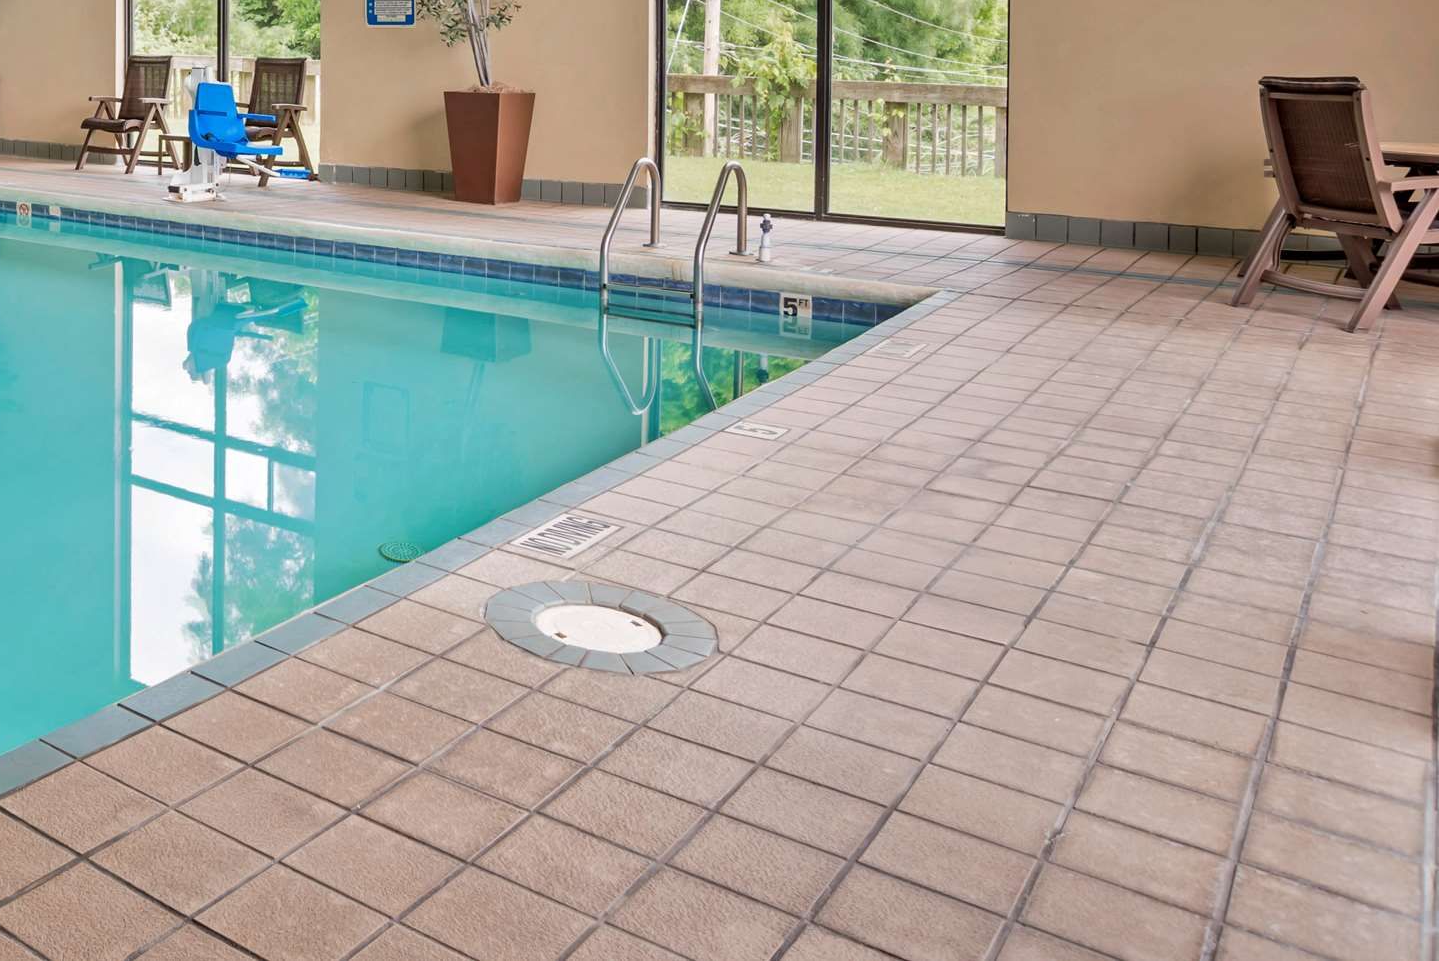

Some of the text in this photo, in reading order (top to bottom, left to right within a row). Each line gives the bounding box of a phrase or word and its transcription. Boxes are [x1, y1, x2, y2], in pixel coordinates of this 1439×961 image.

[783, 296, 809, 317] 5 FT
[537, 516, 611, 546] DIVING
